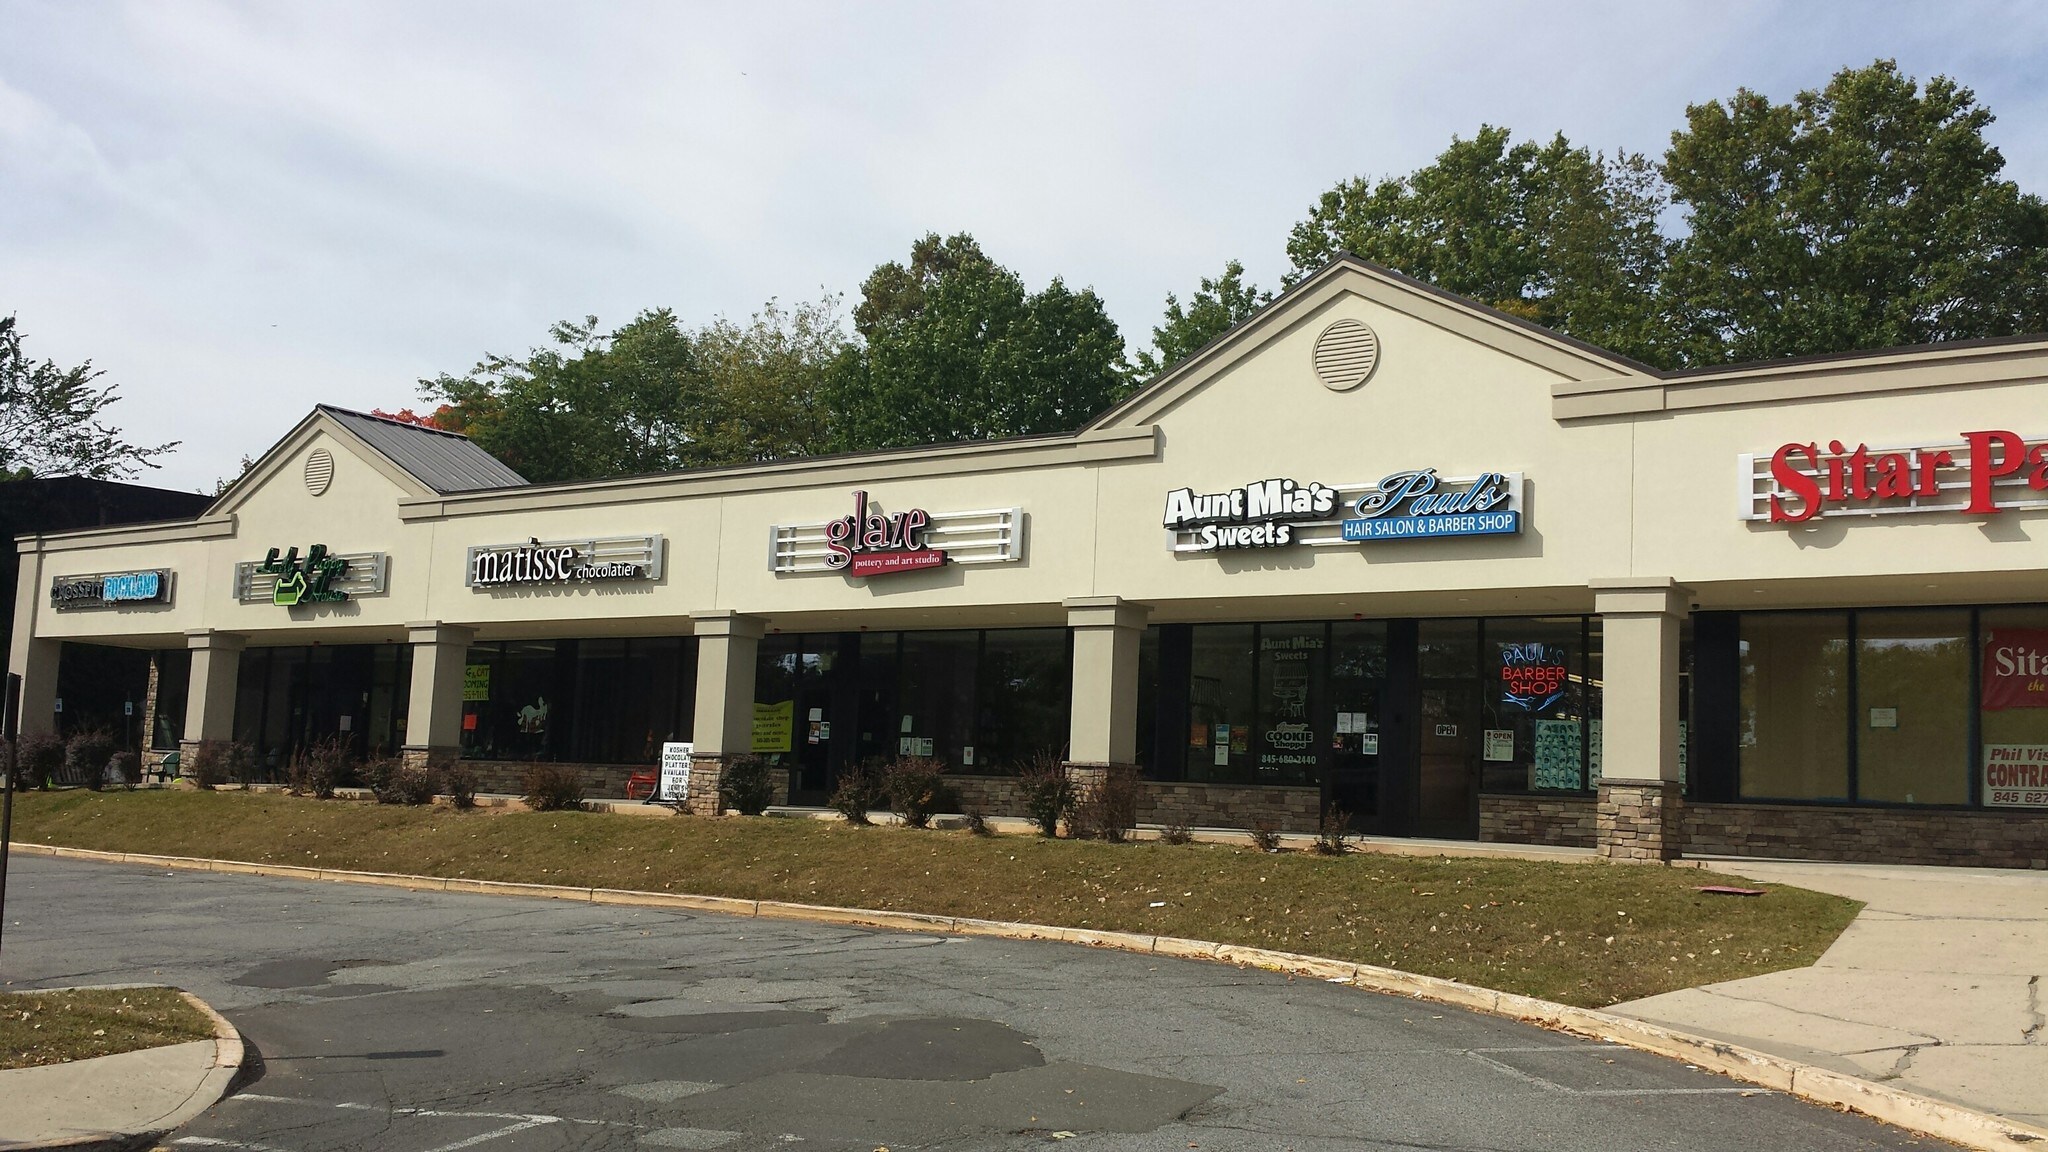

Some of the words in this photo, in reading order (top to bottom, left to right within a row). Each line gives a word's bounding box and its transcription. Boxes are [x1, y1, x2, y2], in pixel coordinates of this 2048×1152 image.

[1770, 440, 1952, 523] Sitar
[1354, 468, 1509, 518] Paul's
[1163, 487, 1245, 527] Aunt
[1246, 478, 1338, 518] Mia's
[824, 490, 928, 568] glaze
[1345, 522, 1372, 537] HAIR
[1375, 520, 1414, 535] SALON
[1417, 520, 1426, 534] &
[1428, 516, 1475, 533] BARBER
[1478, 514, 1513, 530] SHOP
[1201, 522, 1291, 550] Sweets
[473, 536, 574, 583] matisse
[576, 563, 637, 580] chocolatier
[855, 558, 883, 569] pottery
[885, 557, 899, 566] and
[901, 556, 913, 565] art
[915, 554, 940, 564] studio
[50, 581, 103, 601] CROSSFIT
[103, 571, 160, 601] ROCKLAND
[1261, 637, 1290, 650] Aunt
[1292, 635, 1325, 650] Mia's
[1274, 651, 1308, 662] Sweets
[1503, 644, 1564, 666] PAUL'S
[1503, 666, 1566, 681] BARBER
[1509, 681, 1558, 695] SHOP
[2028, 679, 2045, 691] the
[1266, 732, 1312, 742] COOKIE
[1437, 725, 1456, 735] OPEN
[1275, 741, 1306, 749] Shoppe
[1990, 748, 2022, 760] Phil
[1987, 764, 2048, 787] CONTRA
[1993, 791, 2019, 802] 845
[2025, 792, 2048, 803] 627
